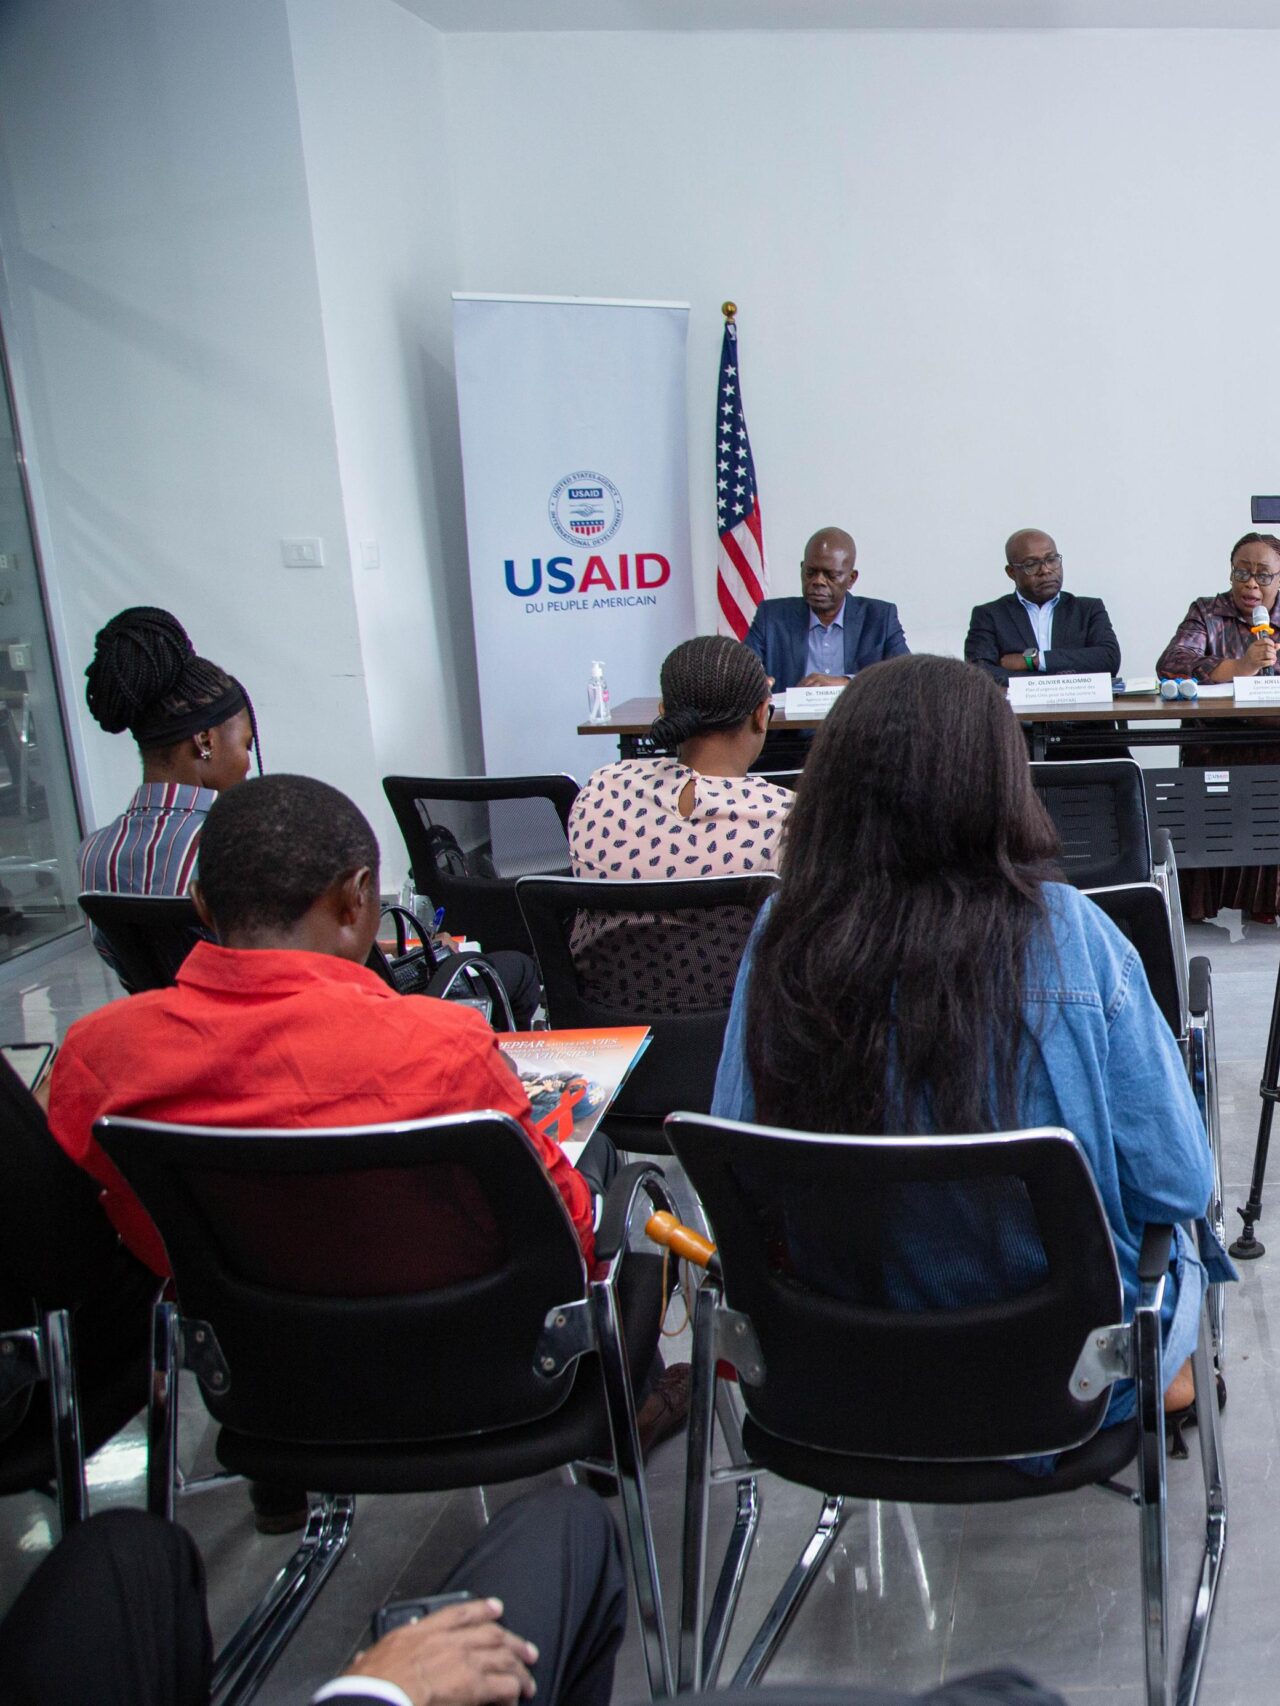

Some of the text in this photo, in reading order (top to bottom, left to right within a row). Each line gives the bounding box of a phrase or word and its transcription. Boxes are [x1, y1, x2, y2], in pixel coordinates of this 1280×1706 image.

[552, 472, 619, 499] UNITED STATES AGENCY
[571, 489, 600, 498] USAID
[550, 508, 622, 547] INTERNATIONAL DEVELOPMENT
[504, 553, 671, 597] USAID
[525, 595, 658, 614] DU PEUPLE AMERICAIN
